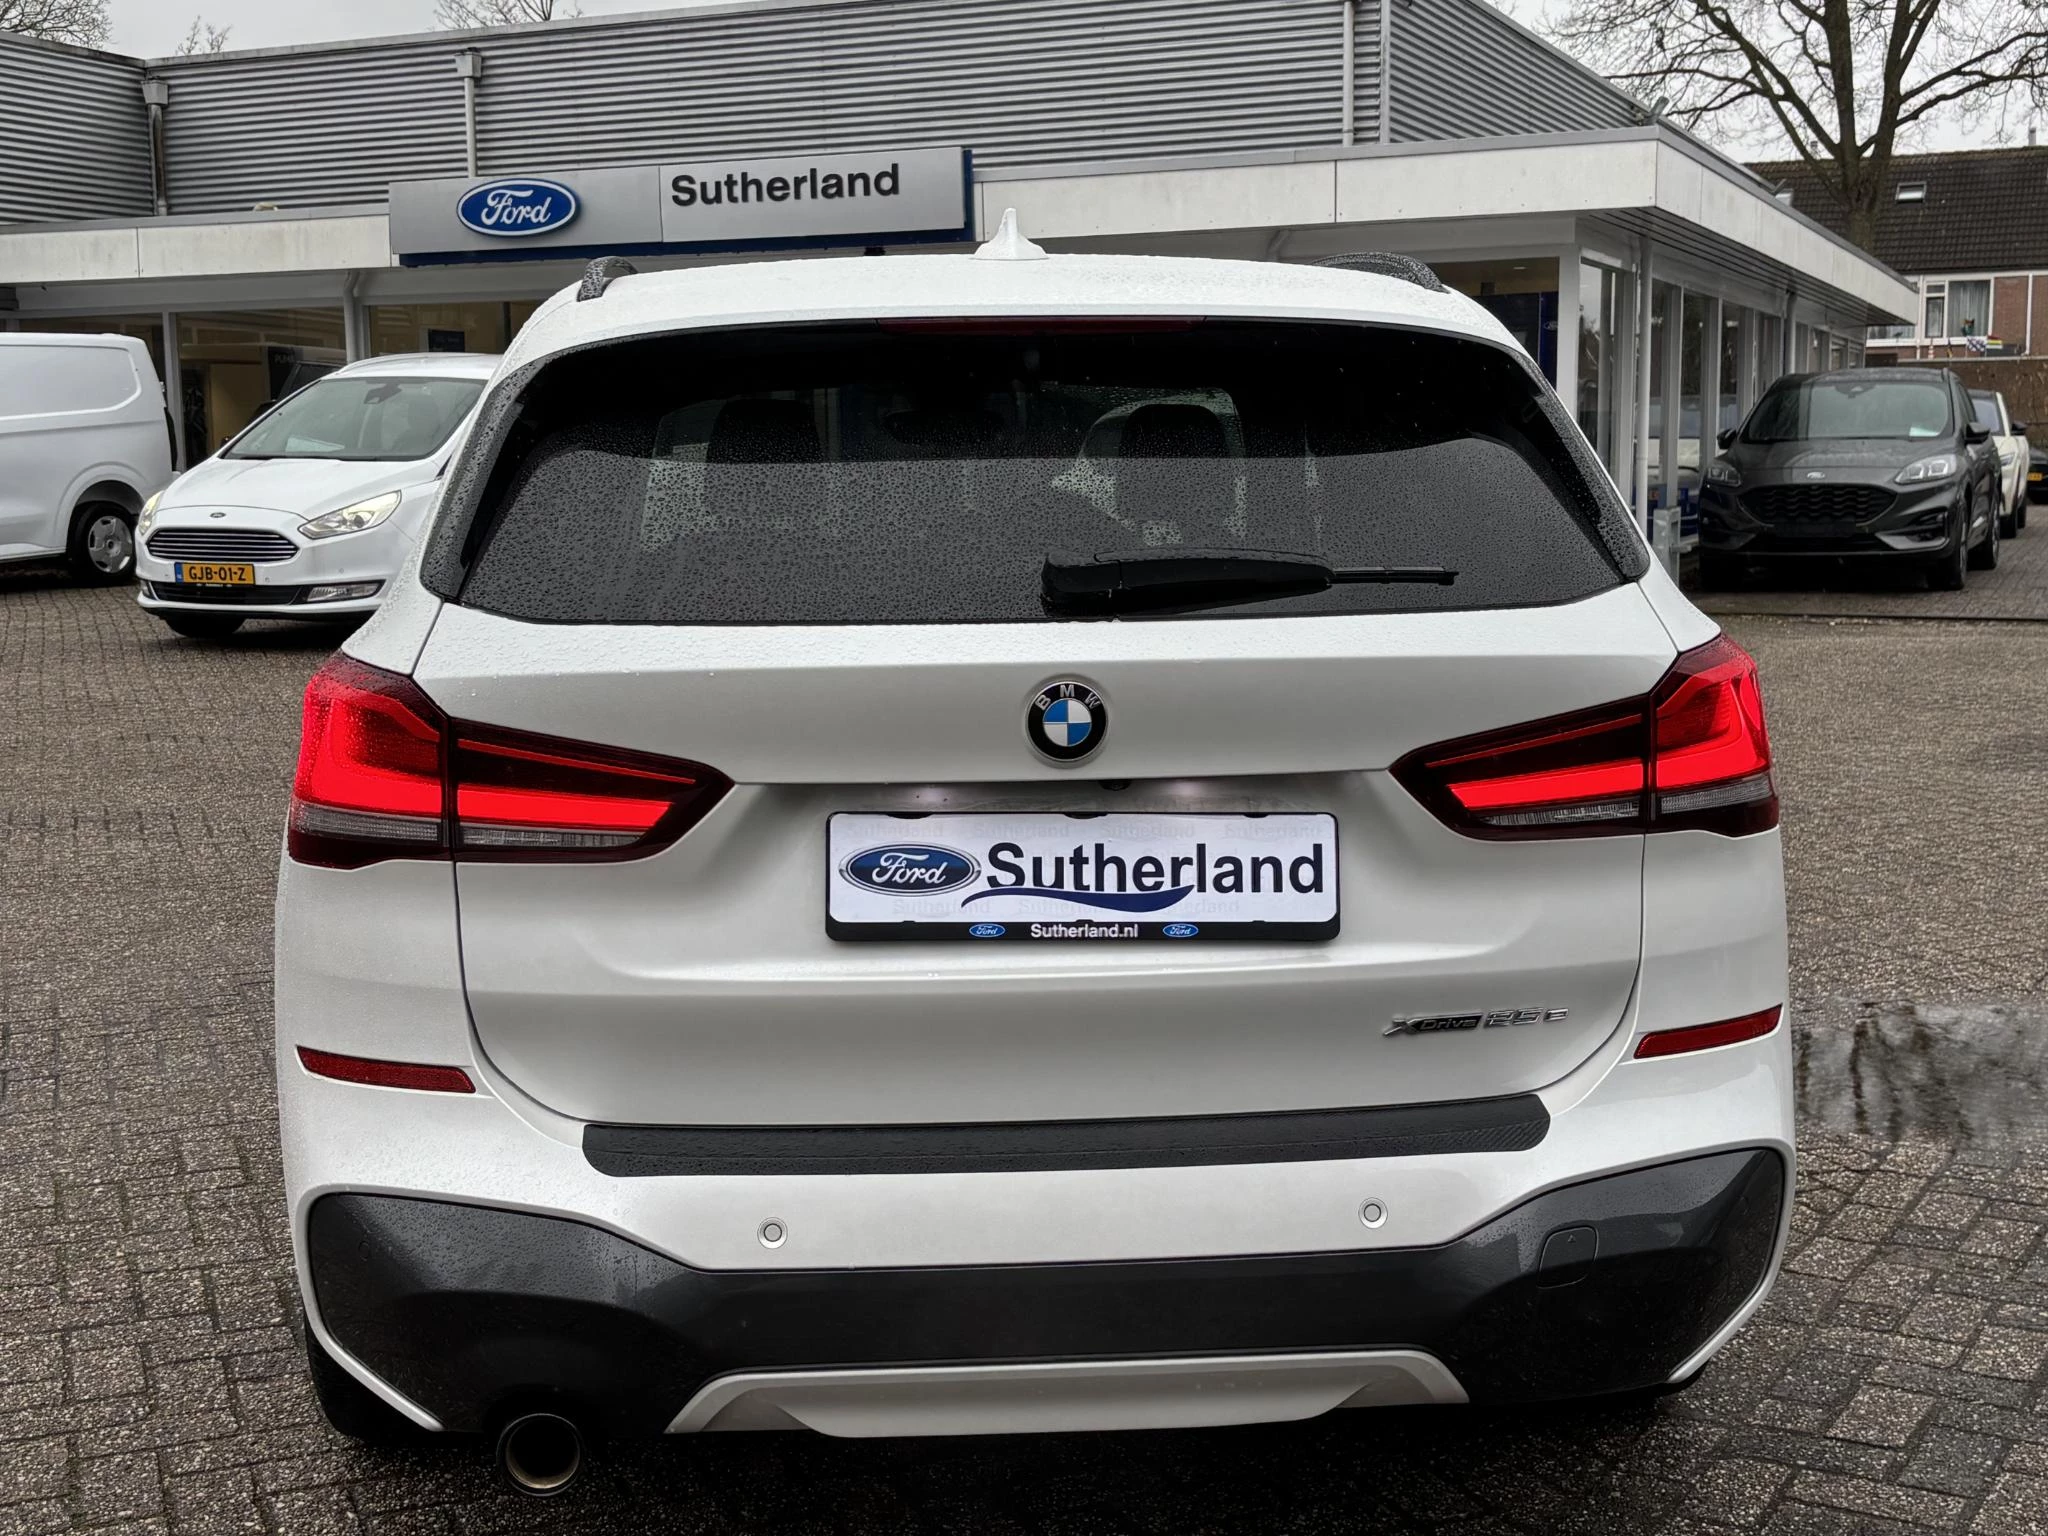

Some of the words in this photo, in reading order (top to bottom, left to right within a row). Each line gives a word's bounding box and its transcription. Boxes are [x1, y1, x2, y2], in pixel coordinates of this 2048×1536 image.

[671, 163, 900, 207] Sutherland
[481, 189, 552, 225] Ford
[189, 566, 246, 581] GJB-01-Z
[1034, 684, 1101, 710] BMW
[871, 852, 948, 884] Ford
[986, 842, 1323, 894] Sutherland
[1030, 923, 1138, 938] Sutherland.nl
